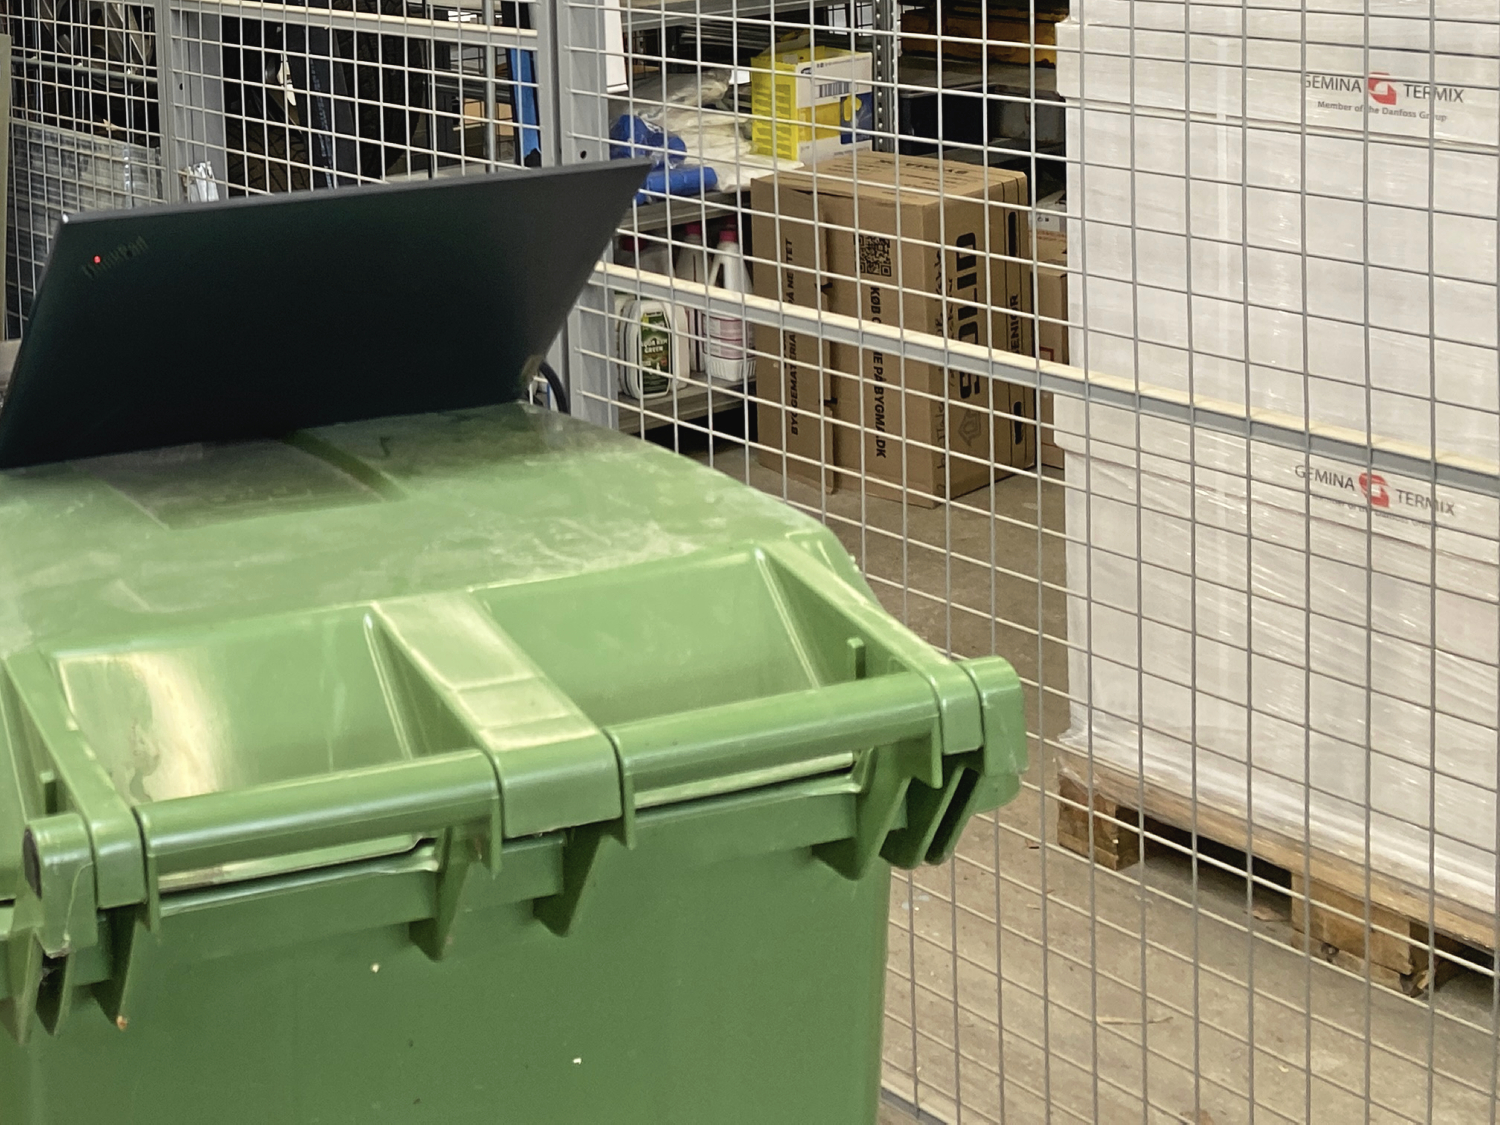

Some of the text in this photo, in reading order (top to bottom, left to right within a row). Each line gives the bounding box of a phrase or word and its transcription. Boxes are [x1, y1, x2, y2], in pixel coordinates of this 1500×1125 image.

[1304, 74, 1362, 93] GEMINA
[1317, 101, 1353, 112] Member
[1381, 107, 1417, 119] Danfoss
[870, 286, 882, 315] KØB
[1294, 465, 1356, 492] GEMINA
[1395, 488, 1456, 516] TERMIX
